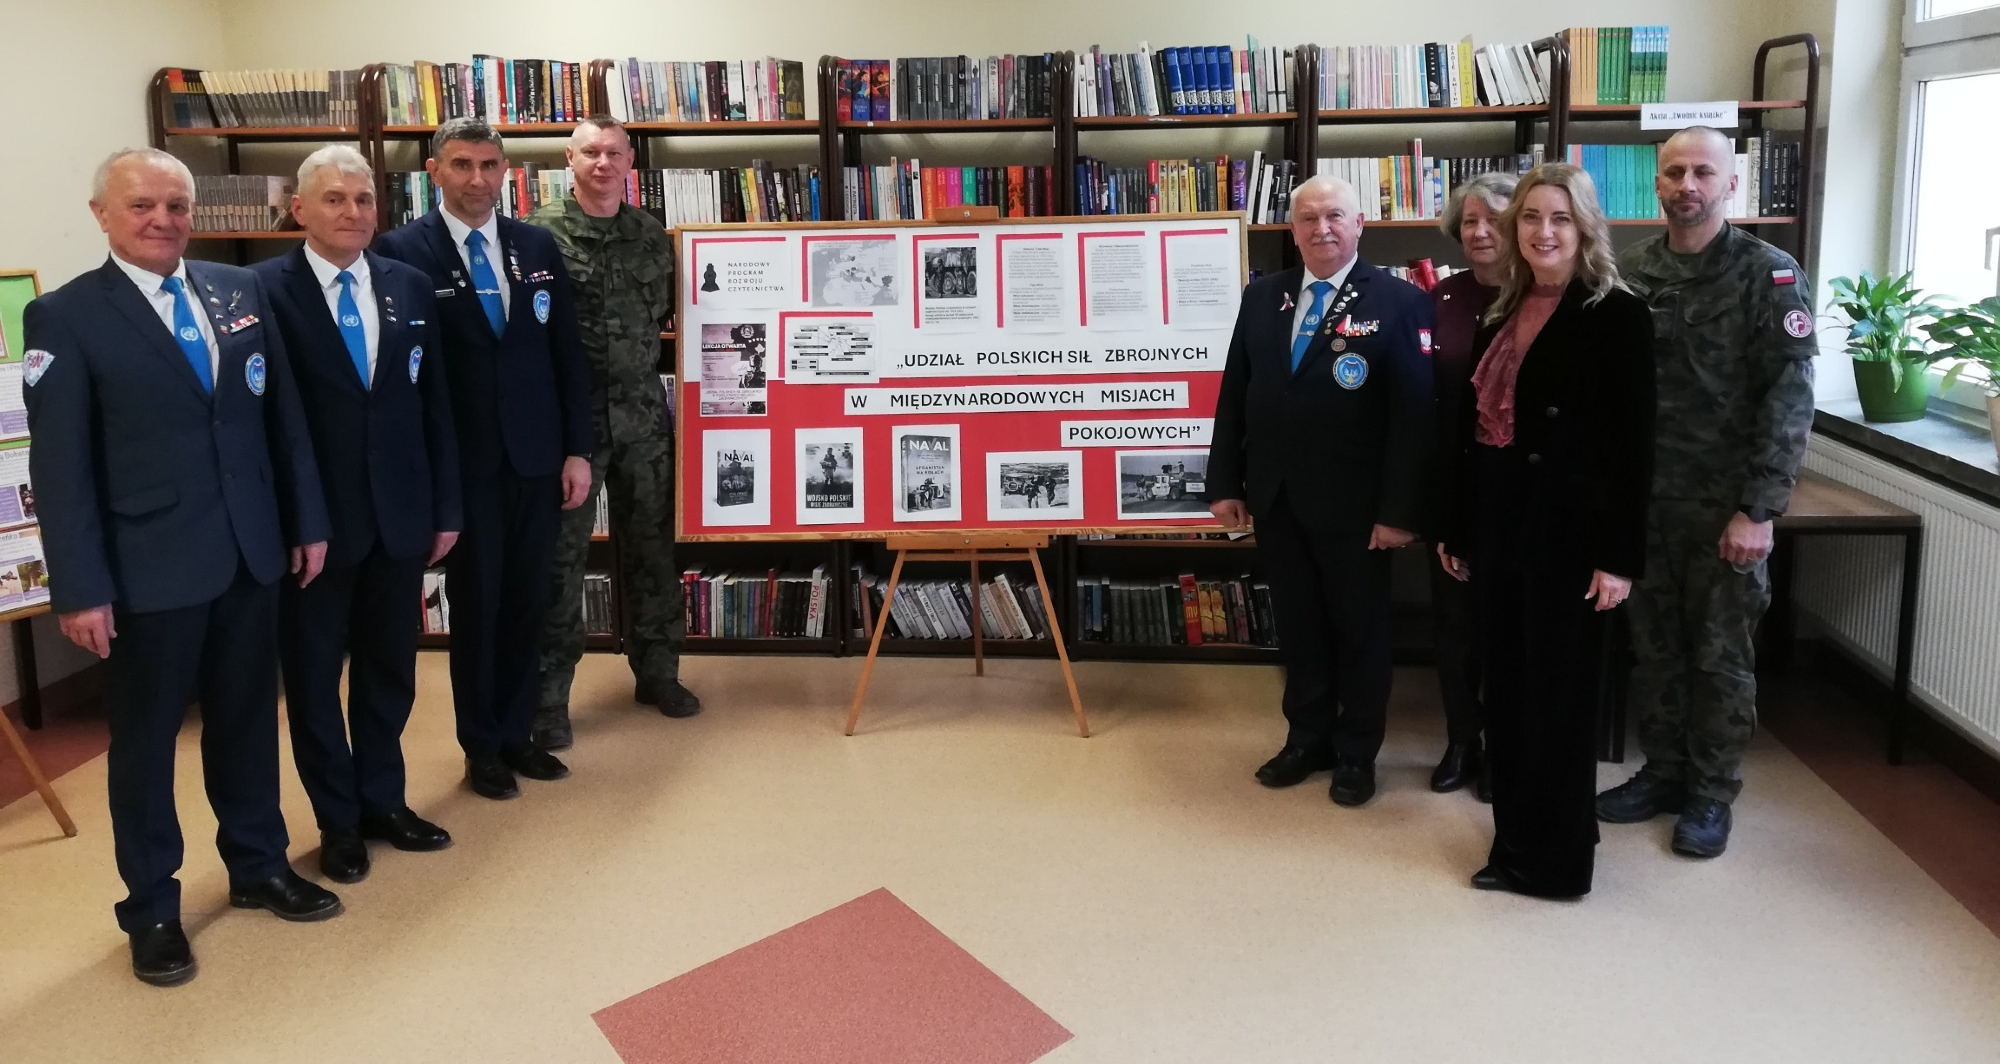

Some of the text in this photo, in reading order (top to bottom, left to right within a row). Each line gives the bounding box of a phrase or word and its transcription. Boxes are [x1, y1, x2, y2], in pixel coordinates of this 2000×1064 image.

[896, 347, 1208, 369] „UDZIAŁ POLSKICH SIŁ ZBROJNYCH
[851, 388, 1175, 409] W MIĘDZYNARODOWYCH MISJACH
[1069, 426, 1201, 440] POKOJOWYCH”
[909, 438, 950, 451] NAVAL
[725, 451, 755, 462] NAVAL
[807, 494, 852, 502] WOJSKO POLSKIE
[808, 585, 821, 620] POLSKA
